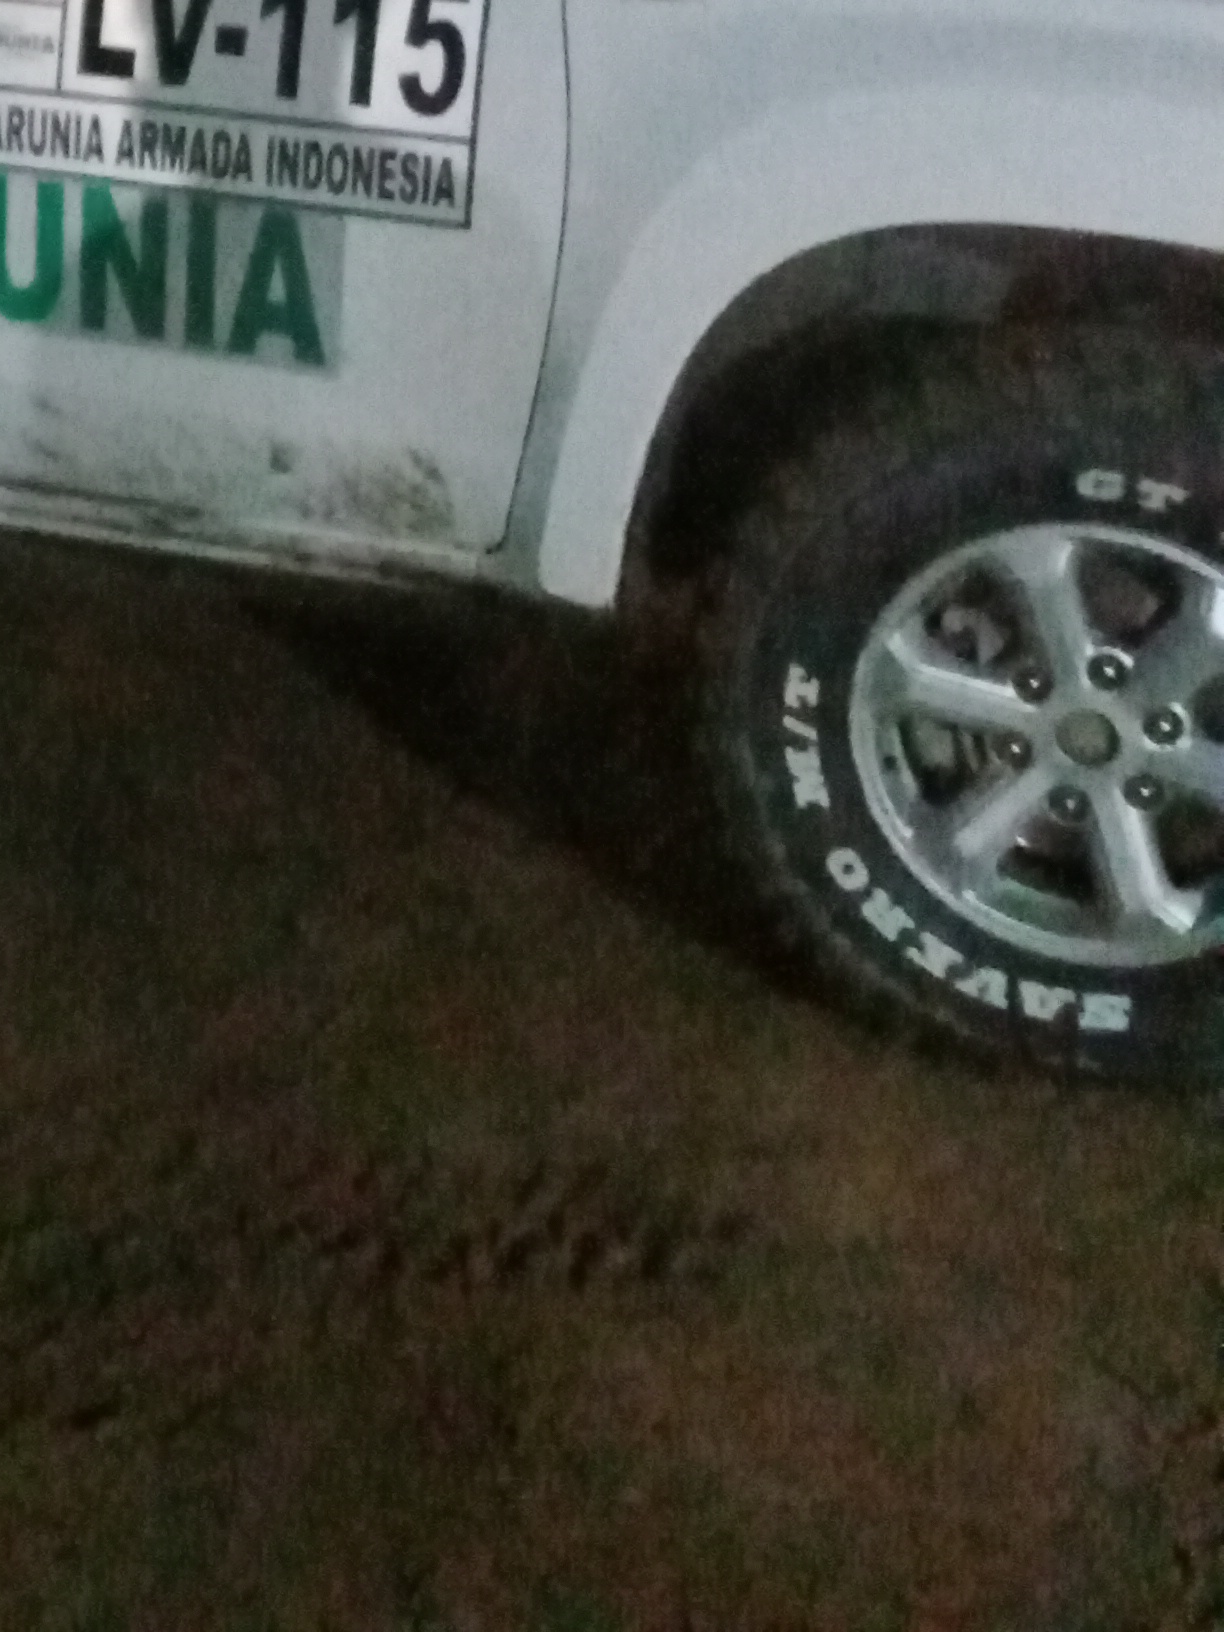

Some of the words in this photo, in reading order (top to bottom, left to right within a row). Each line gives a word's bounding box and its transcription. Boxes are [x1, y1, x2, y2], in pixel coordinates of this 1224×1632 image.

[115, 117, 254, 183] ARMADA
[266, 137, 456, 208] INDONESIA
[1077, 469, 1189, 513] GT
